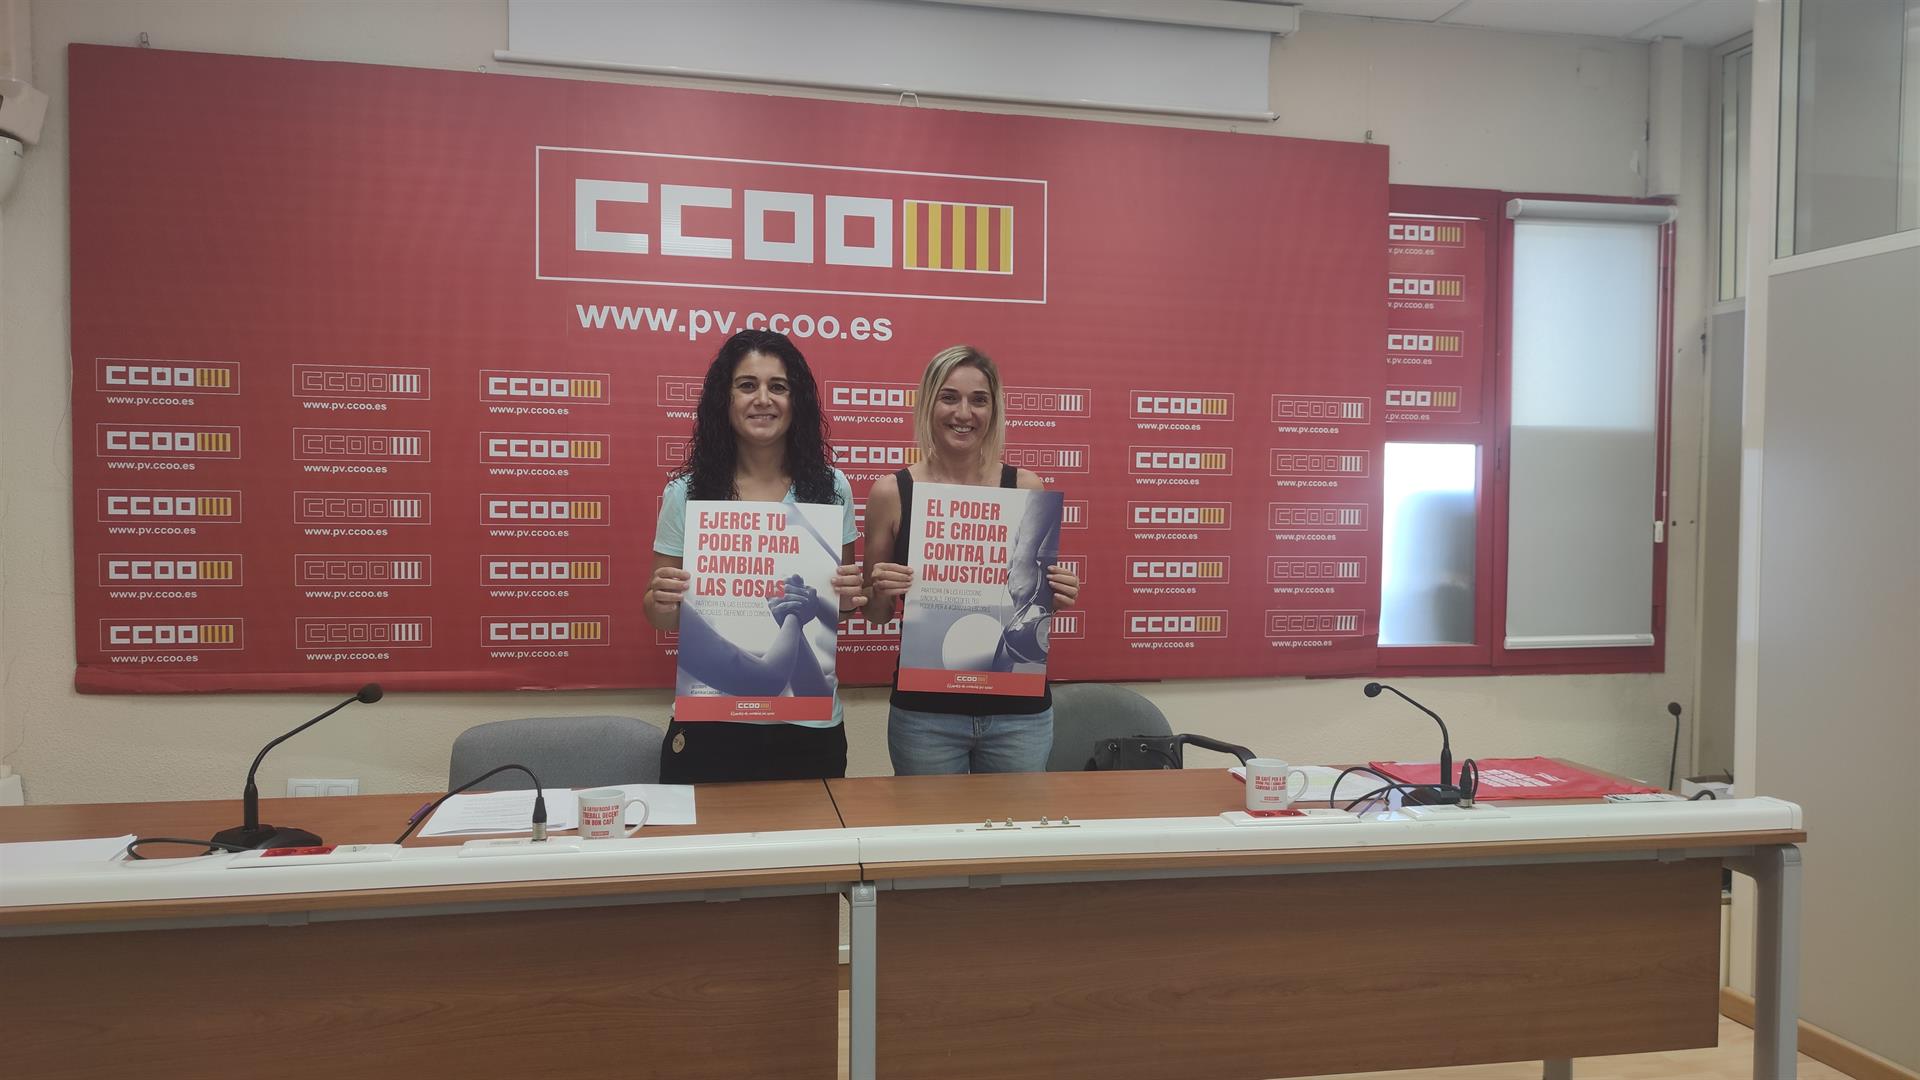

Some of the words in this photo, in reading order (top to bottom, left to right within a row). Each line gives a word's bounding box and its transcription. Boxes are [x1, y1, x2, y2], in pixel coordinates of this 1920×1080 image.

[576, 179, 893, 268] CCOO
[1389, 224, 1435, 241] COO
[1389, 279, 1434, 295] COO
[576, 304, 893, 341] www.pv.ccoo.es
[1388, 334, 1433, 351] COO
[106, 366, 195, 387] CCOO
[302, 371, 389, 391] CCOO
[489, 377, 569, 396] CCOO
[107, 395, 195, 407] www.pv.ccoo.es
[833, 388, 904, 406] CCOO
[1137, 397, 1201, 414] CCOO
[1386, 390, 1431, 406] COO
[303, 401, 387, 411] www.pv.ccoo.es
[490, 405, 569, 416] www.pv.ccoo.es
[1278, 400, 1339, 418] CCOO
[834, 415, 903, 423] www.pv.ccoo.es
[1138, 423, 1200, 431] www.pv.ccoo.es
[1279, 426, 1339, 434] www.pv.ccoo.es
[107, 431, 195, 451] CCOO
[303, 434, 389, 454] CCOO
[489, 439, 569, 458] CCOO
[833, 446, 903, 464] CCOO
[1136, 452, 1200, 469] CCOO
[1277, 455, 1338, 471] CCOO
[108, 461, 195, 471] www.pv.ccoo.es
[304, 464, 387, 474] www.pv.ccoo.es
[490, 467, 569, 477] www.pv.ccoo.es
[1136, 478, 1199, 486] www.pv.ccoo.es
[1278, 480, 1338, 488] www.pv.ccoo.es
[108, 496, 196, 516] CCOO
[304, 498, 389, 517] CCOO
[489, 501, 569, 519] CCOO
[927, 499, 944, 517] EL
[950, 500, 1000, 520] PODER
[700, 512, 761, 530] EJERCE
[767, 513, 786, 531] TU
[1134, 507, 1198, 524] CCOO
[1275, 508, 1337, 525] CCOO
[109, 526, 196, 536] www.pv.ccoo.es
[305, 527, 388, 537] www.pv.ccoo.es
[490, 528, 569, 538] www.pv.ccoo.es
[925, 521, 945, 539] DE
[951, 524, 1007, 542] CRIDAR
[698, 534, 752, 552] PODER
[759, 536, 799, 554] PARA
[924, 543, 984, 562] CONTRA
[990, 546, 1007, 563] LA
[109, 560, 197, 580] CCOO
[304, 561, 390, 580] CCOO
[490, 562, 570, 579] CCOO
[697, 555, 774, 575] CAMBIAR
[1133, 562, 1197, 578] CCOO
[1274, 562, 1335, 578] CCOO
[110, 590, 197, 600] www.pv.ccoo.es
[306, 589, 388, 599] www.pv.ccoo.es
[490, 589, 569, 598] www.pv.ccoo.es
[696, 578, 727, 596] LAS
[732, 579, 785, 598] COSAS
[1133, 587, 1196, 595] www.pv.ccoo.es
[1274, 587, 1334, 595] www.pv.ccoo.es
[490, 622, 570, 640] CCOO
[1131, 616, 1195, 632] CCOO
[1272, 615, 1333, 632] CCOO
[110, 625, 198, 644] CCOO
[305, 623, 391, 643] CCOO
[490, 649, 569, 658] www.pv.ccoo.es
[1131, 641, 1194, 649] www.pv.ccoo.es
[111, 654, 198, 664] www.pv.ccoo.es
[306, 652, 389, 662] www.pv.ccoo.es
